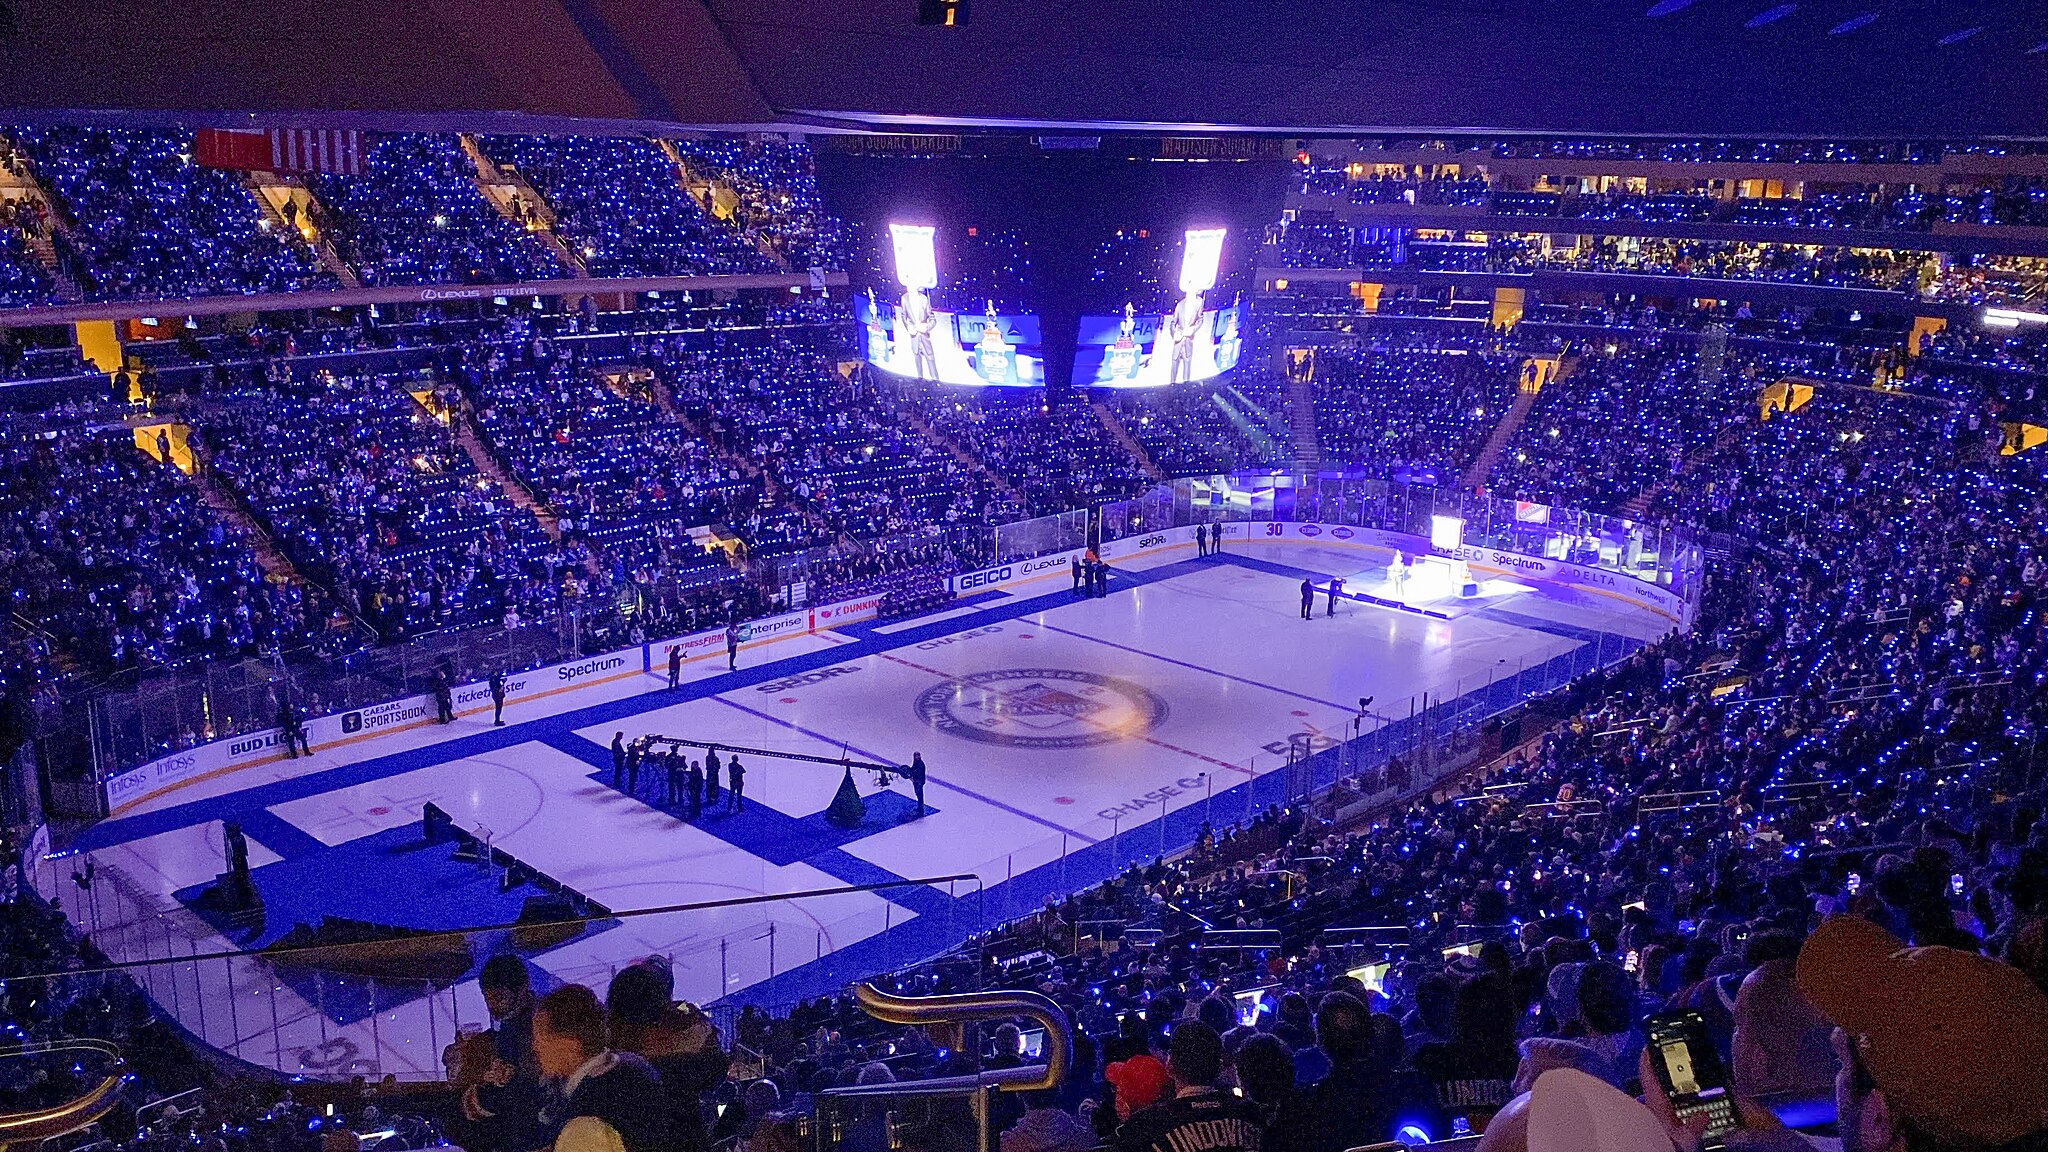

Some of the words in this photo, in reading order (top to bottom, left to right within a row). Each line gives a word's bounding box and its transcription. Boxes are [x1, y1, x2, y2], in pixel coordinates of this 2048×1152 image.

[437, 289, 480, 300] LEXUS
[492, 288, 514, 296] SUITE
[515, 287, 538, 296] LEVEL
[1266, 522, 1283, 537] 30
[1033, 557, 1067, 571] LEXUS
[1492, 553, 1542, 571] Spectrum
[960, 566, 1012, 590] GEICO
[1572, 568, 1616, 587] DELTA
[1634, 586, 1666, 604] Northwell
[558, 657, 622, 681] Spectrum
[457, 680, 527, 704] ticketster
[363, 702, 402, 717] CAESARS
[364, 705, 427, 729] SPORTSBOOK
[231, 738, 264, 756] BUD
[265, 726, 310, 748] LIGT
[156, 754, 196, 776] Infosys
[111, 772, 147, 796] Infosys
[1097, 785, 1183, 820] CHASE
